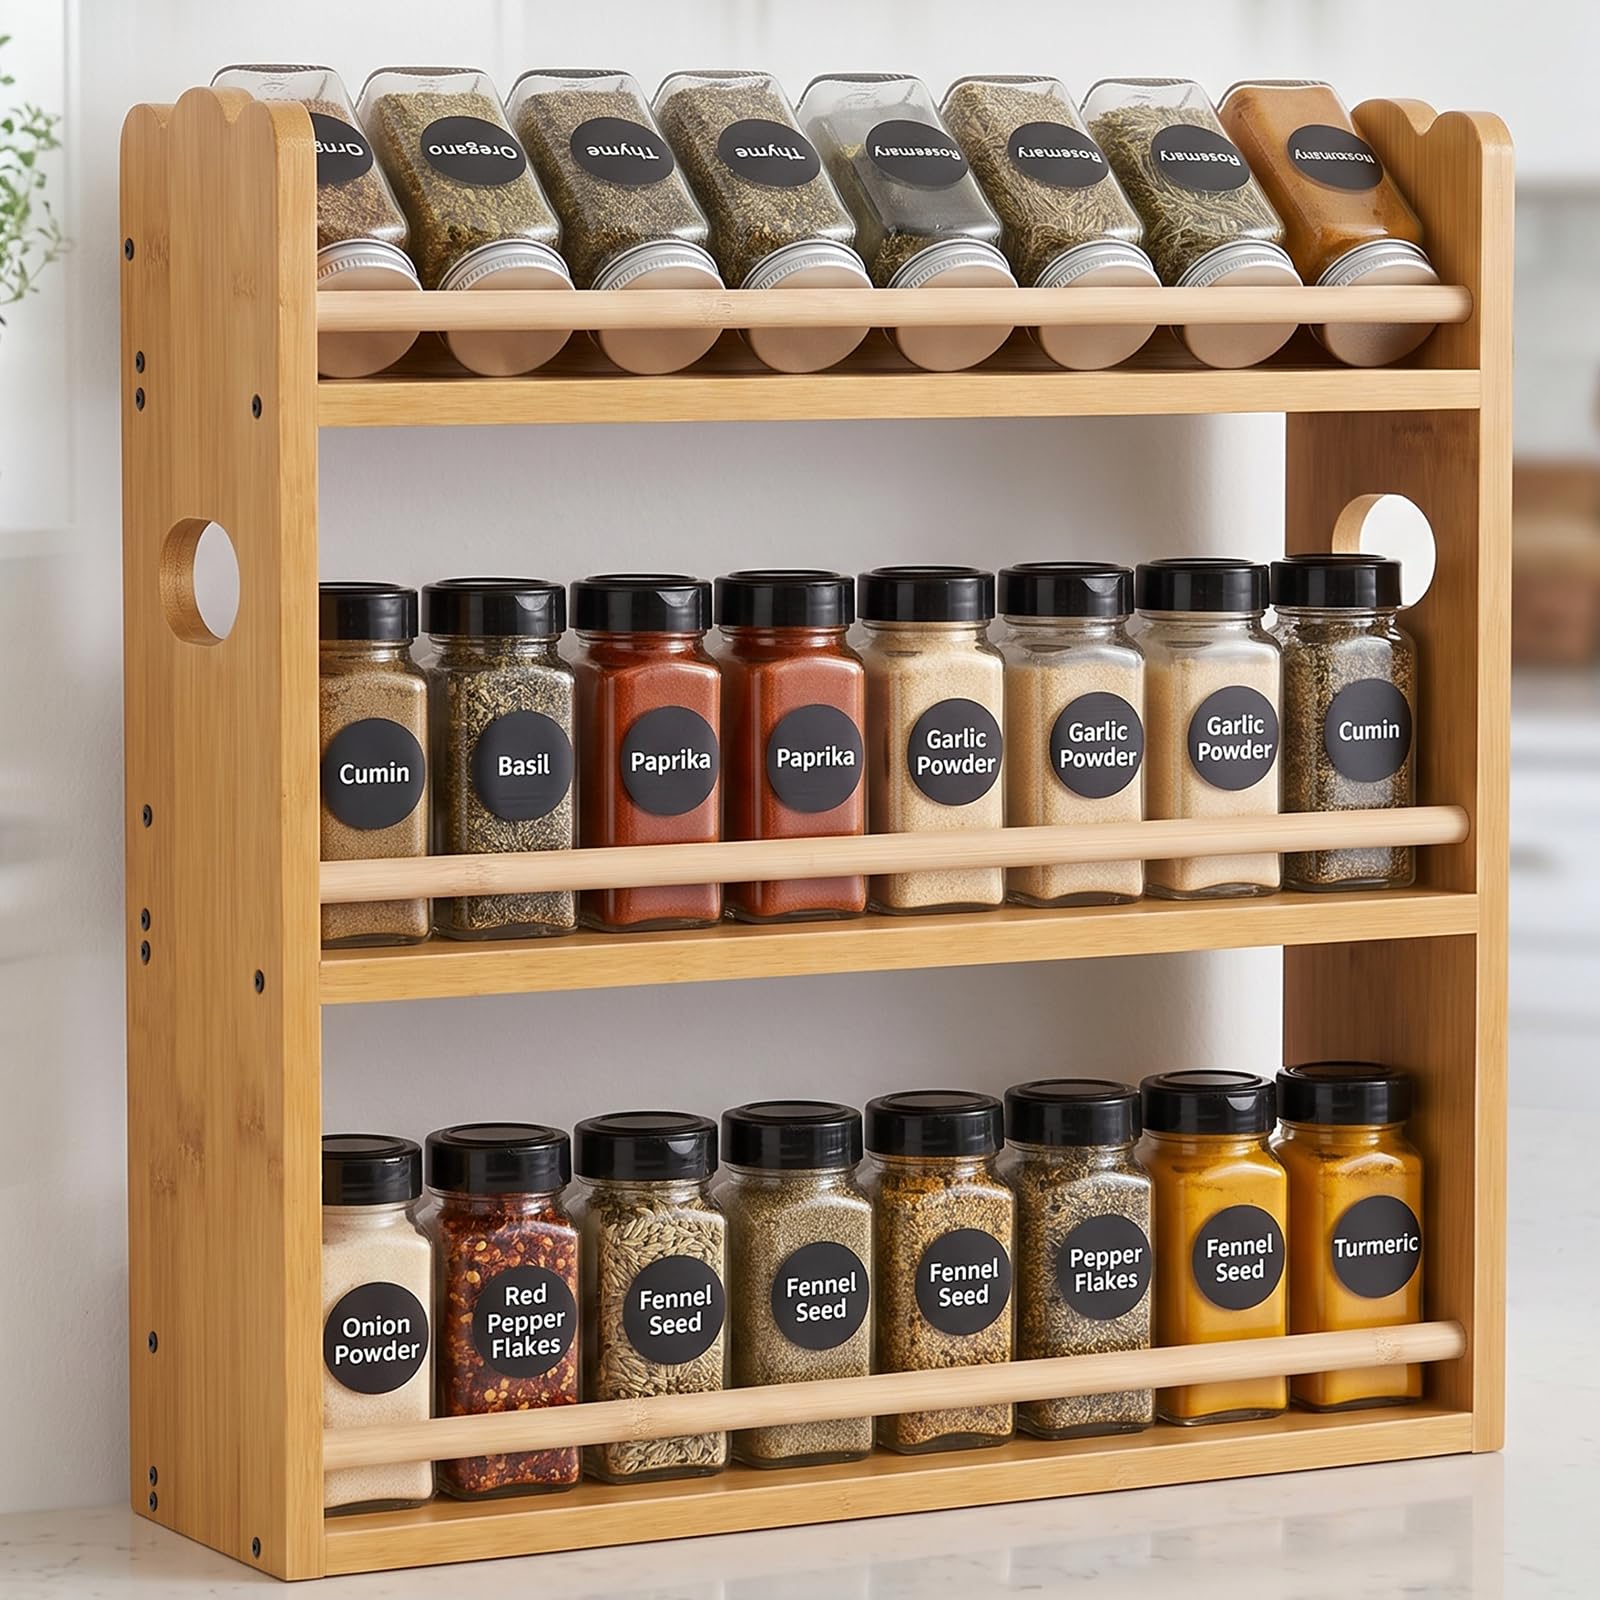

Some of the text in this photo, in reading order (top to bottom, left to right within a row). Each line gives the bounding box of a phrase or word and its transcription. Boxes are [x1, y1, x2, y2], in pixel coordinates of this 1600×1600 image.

[428, 141, 518, 159] Oregano
[586, 142, 660, 160] Thyme
[734, 143, 806, 161] Thyme
[1018, 146, 1103, 164] Rosemary
[1160, 149, 1242, 167] Rosemary
[1068, 720, 1128, 743] Garlic
[1206, 713, 1265, 736] Garlic
[1338, 718, 1400, 742] Cumin
[926, 727, 987, 750] Garlic
[1198, 738, 1273, 762] Powder
[498, 753, 551, 777] Basil
[631, 748, 711, 776] Paprika
[777, 745, 855, 772] Paprika
[917, 753, 997, 776] Powder
[1060, 746, 1138, 769] Powder
[339, 761, 410, 785] Cumin
[1207, 1232, 1274, 1258] Fennel
[1333, 1232, 1418, 1258] Turmeric
[930, 1257, 999, 1283] Fennel
[1070, 1247, 1143, 1271] Pepper
[1216, 1258, 1264, 1283] Seed
[787, 1271, 857, 1298] Fennel
[1075, 1270, 1138, 1293] Flakes
[505, 1282, 547, 1306] Red
[640, 1283, 712, 1311] Fennel
[938, 1283, 989, 1307] Seed
[796, 1297, 847, 1322] Seed
[342, 1314, 411, 1338] Onion
[488, 1311, 566, 1337] Pepper
[649, 1310, 702, 1336] Seed
[335, 1339, 421, 1365] Powder
[492, 1335, 561, 1359] Flakes
